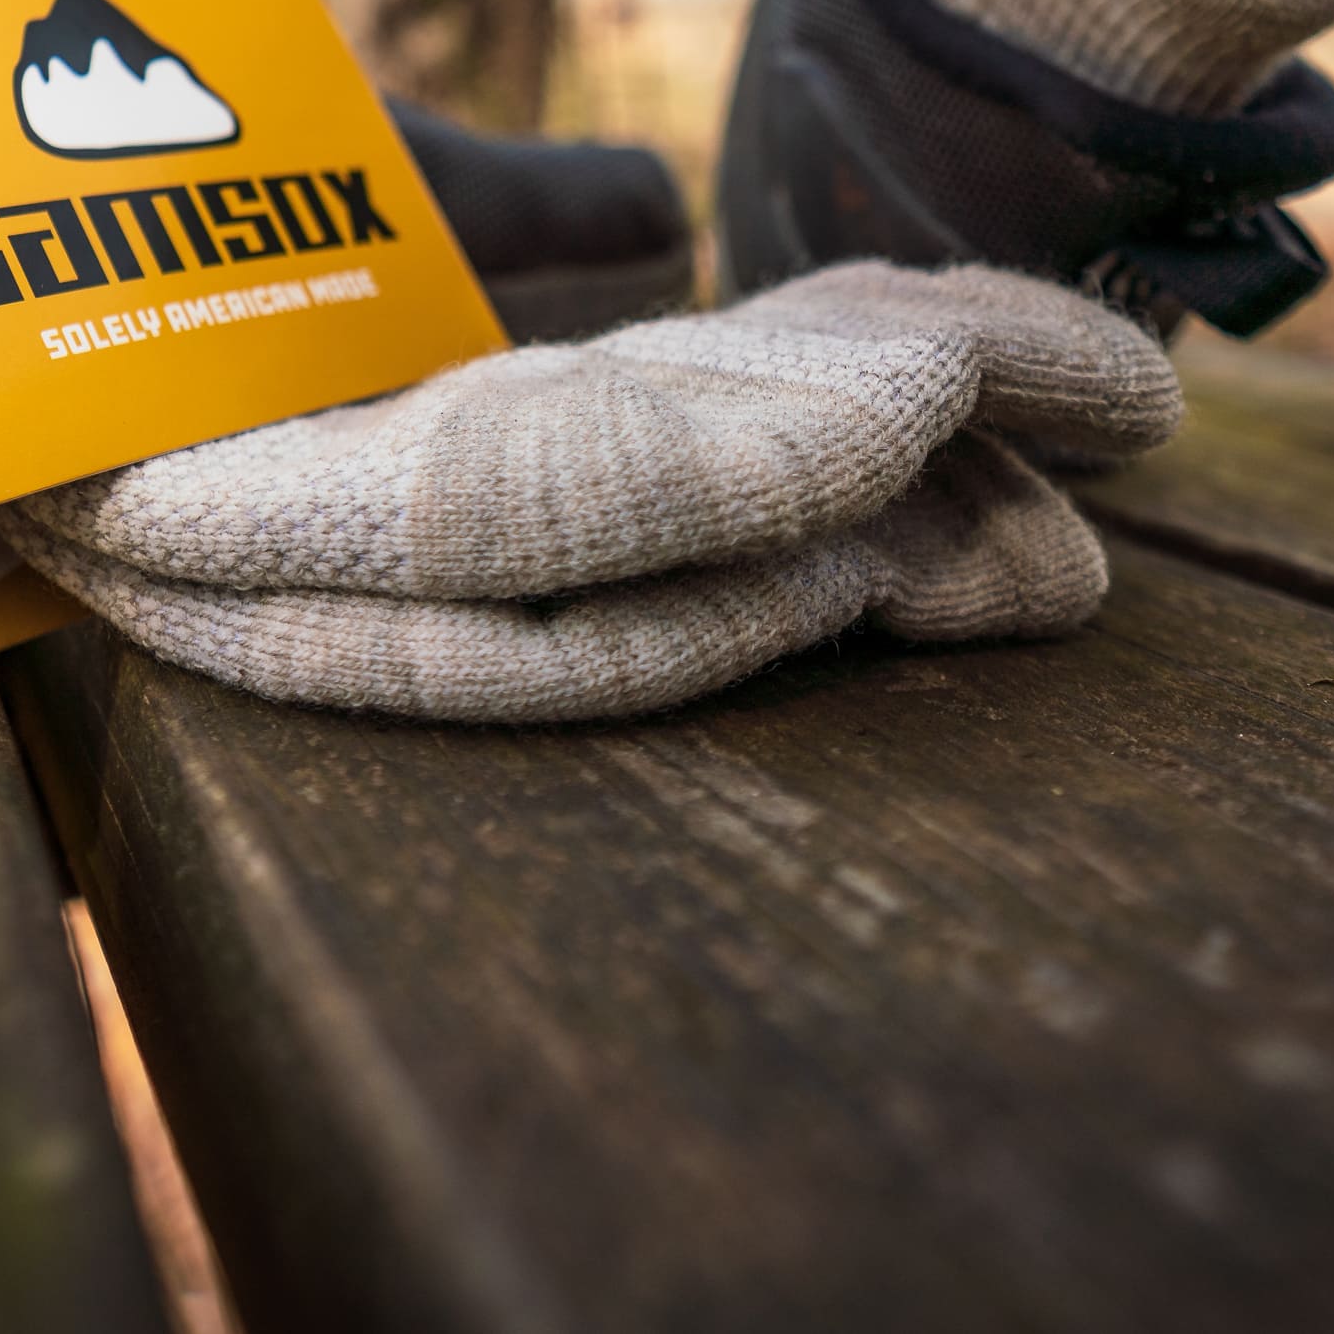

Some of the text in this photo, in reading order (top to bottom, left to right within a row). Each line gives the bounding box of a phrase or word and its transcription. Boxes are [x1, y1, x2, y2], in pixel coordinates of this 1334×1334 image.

[40, 268, 380, 360] SOLELY AMERICAN MADE
